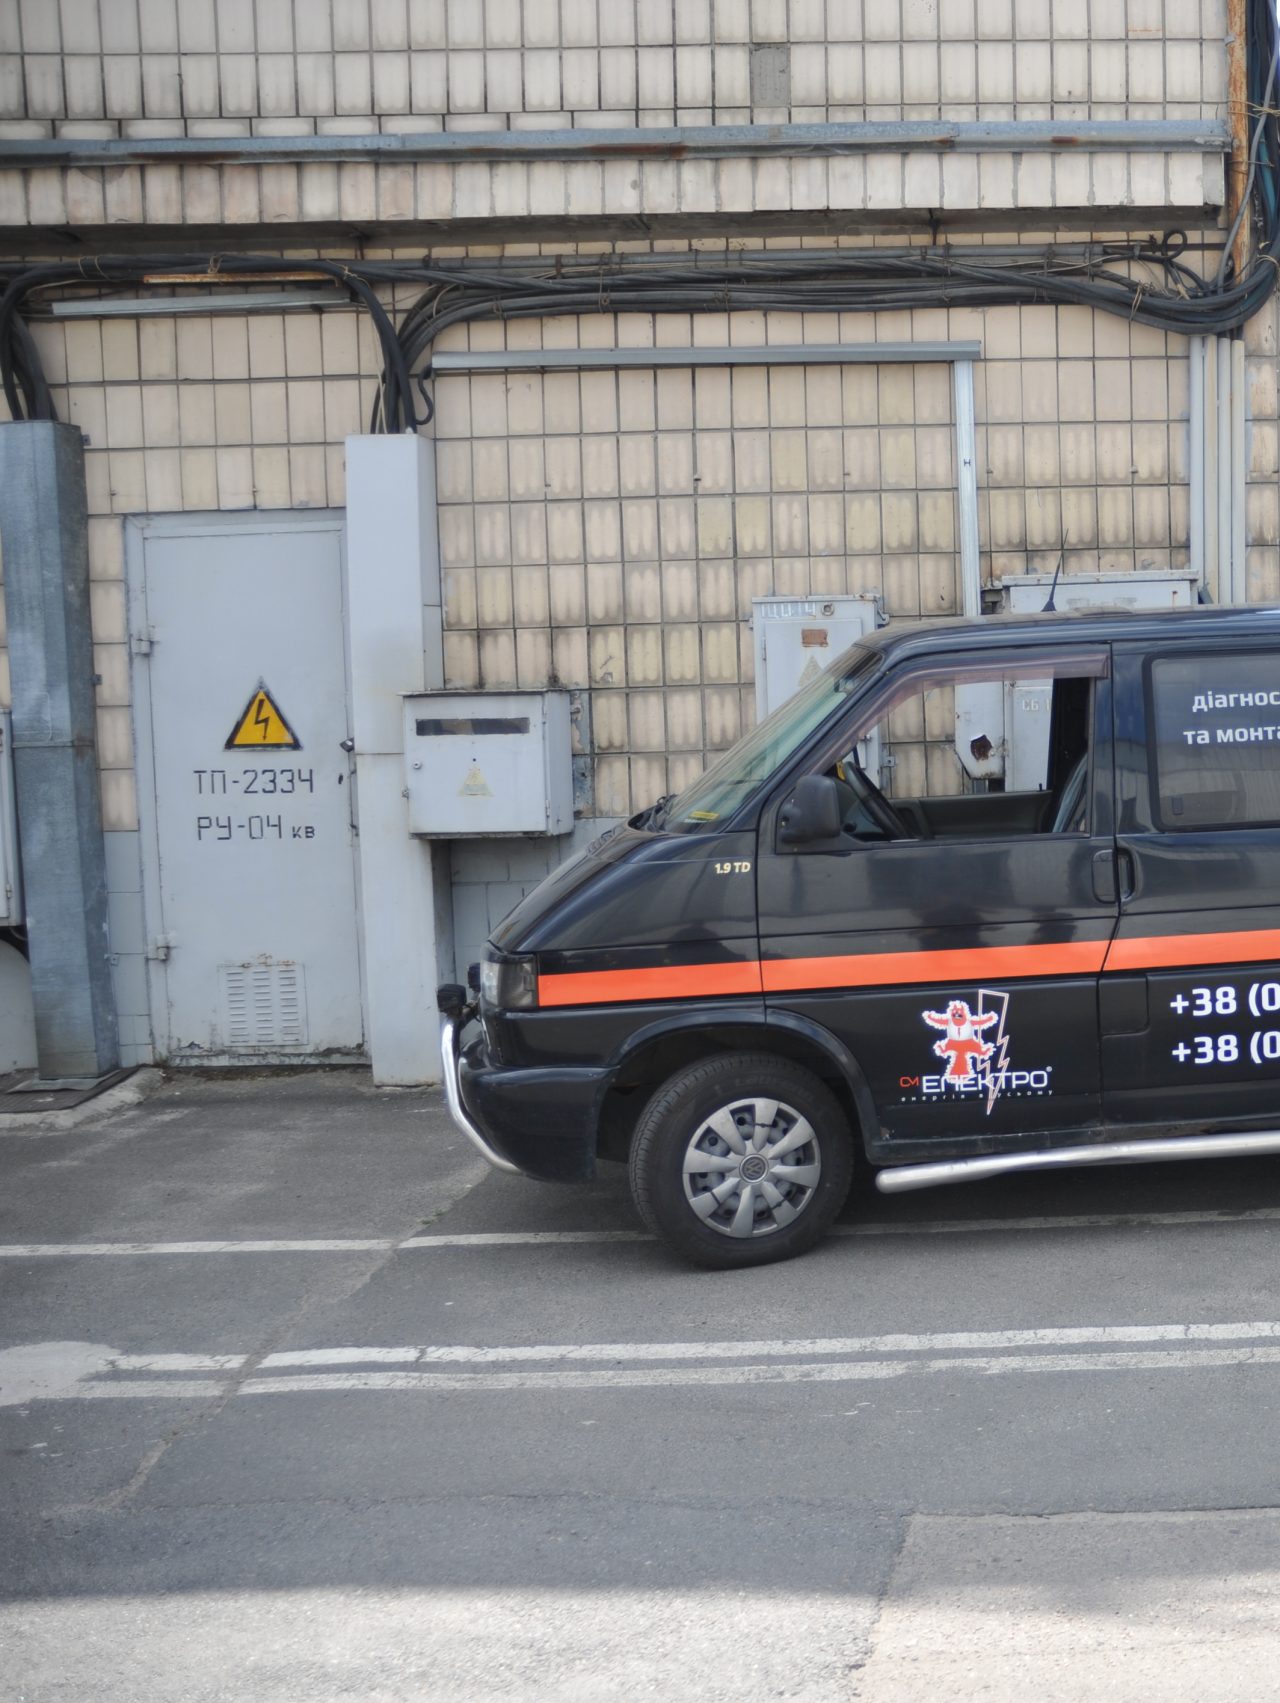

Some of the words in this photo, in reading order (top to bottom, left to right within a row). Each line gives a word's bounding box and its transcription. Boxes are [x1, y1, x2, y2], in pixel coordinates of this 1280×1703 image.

[1183, 728, 1211, 746] та
[193, 768, 314, 795] ТП-2334
[714, 861, 732, 874] 1.9
[733, 861, 751, 873] TD
[1169, 985, 1237, 1017] +38
[1171, 1033, 1239, 1064] +38
